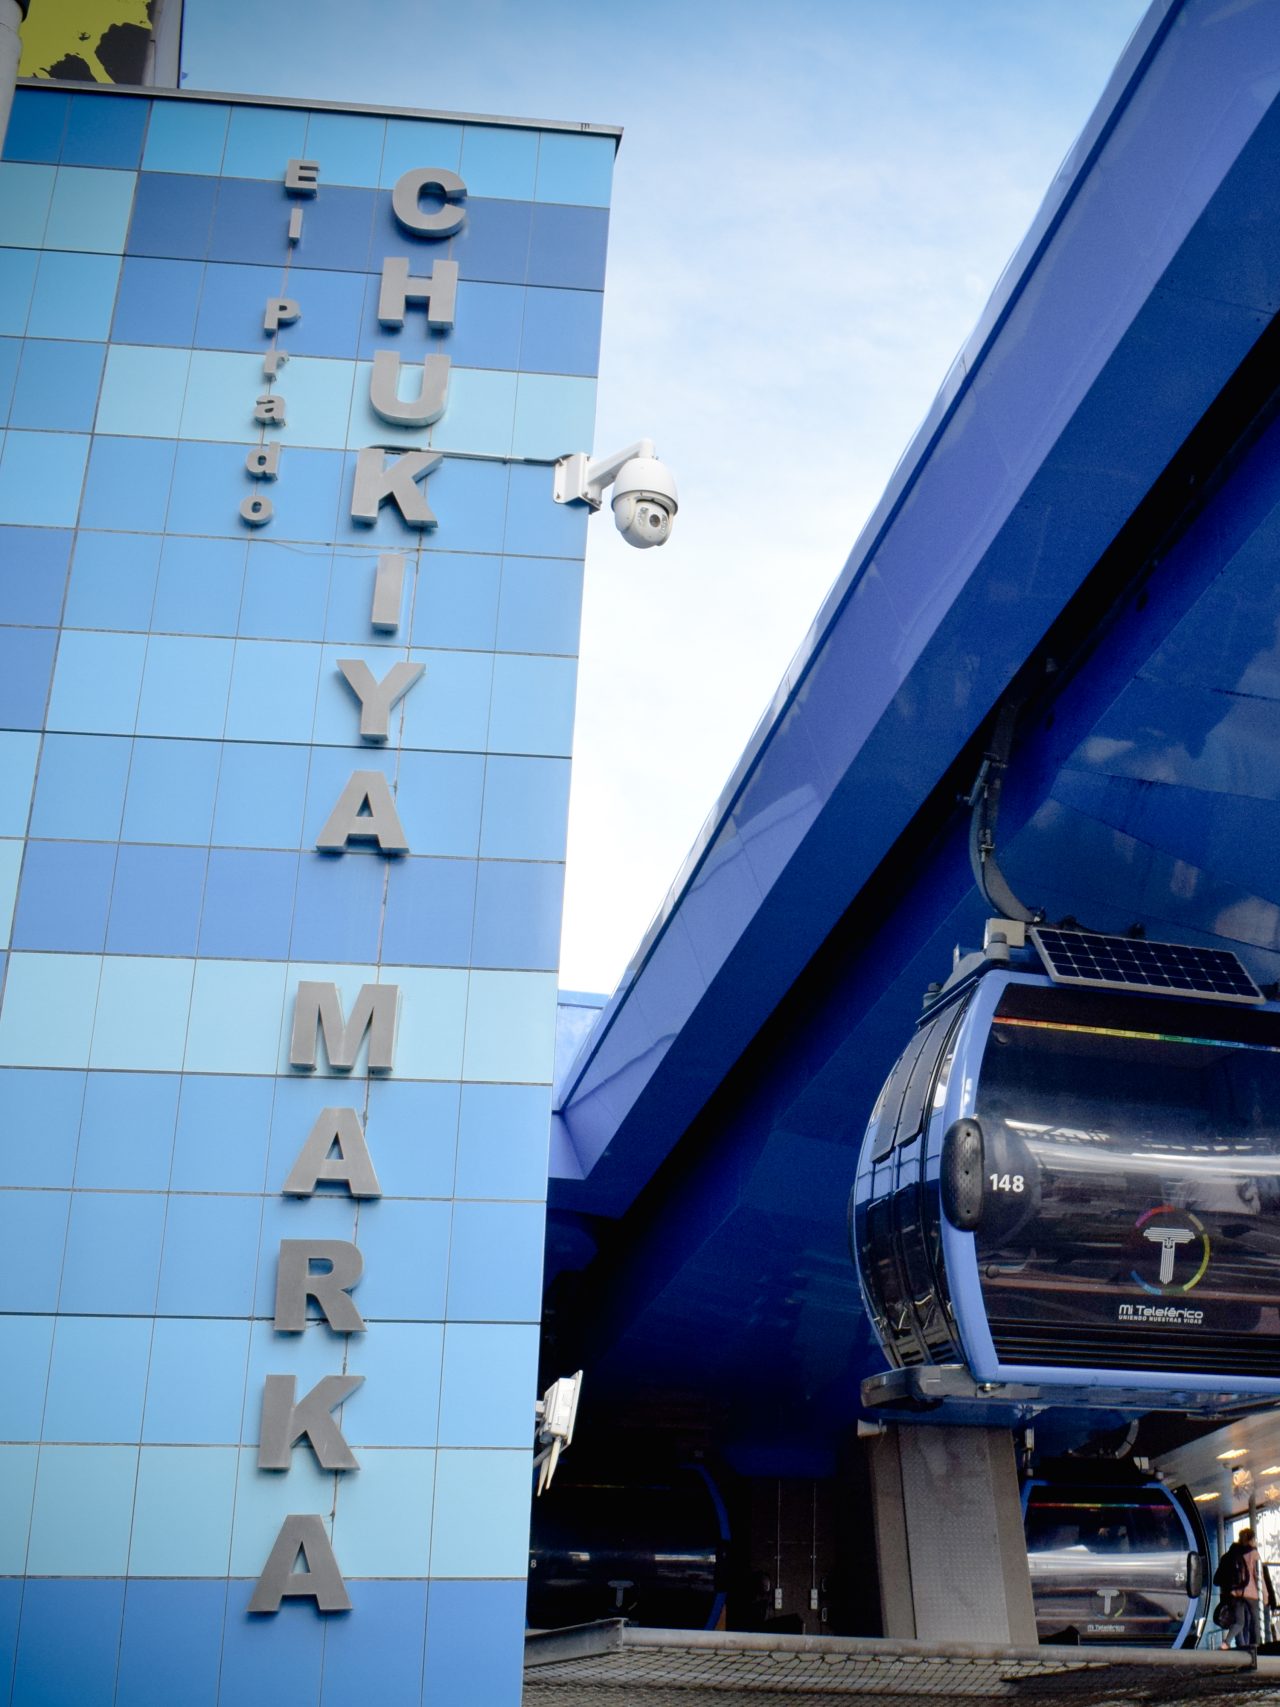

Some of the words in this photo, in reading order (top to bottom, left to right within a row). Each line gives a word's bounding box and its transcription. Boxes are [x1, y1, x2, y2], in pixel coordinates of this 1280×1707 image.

[239, 298, 301, 526] Prado
[315, 167, 468, 856] CHUKIYA
[246, 980, 400, 1613] MARKA
[989, 1173, 1025, 1193] 148
